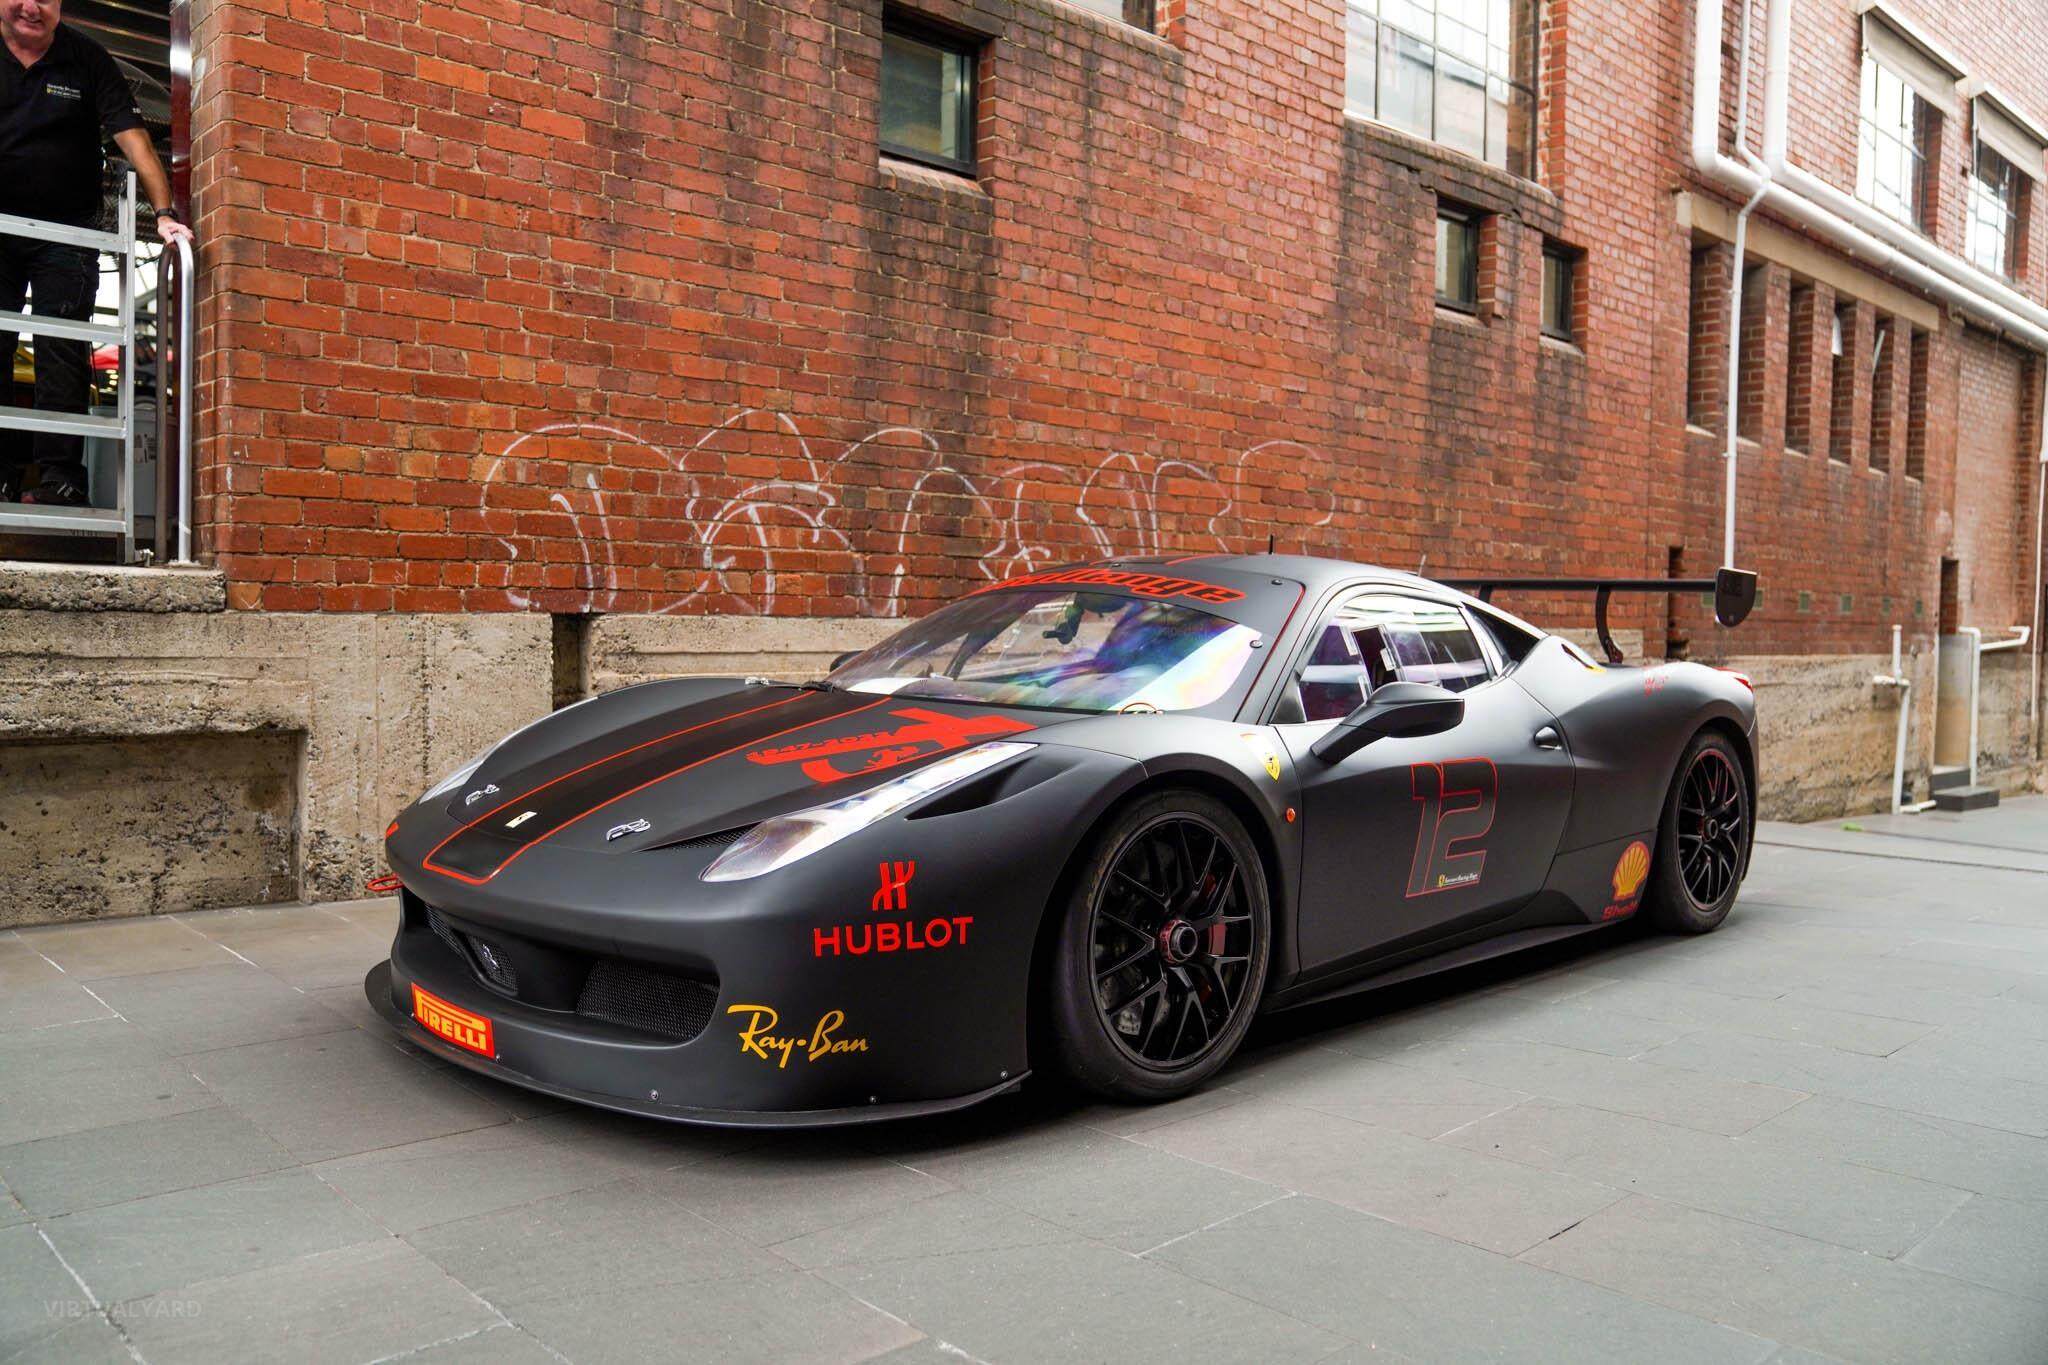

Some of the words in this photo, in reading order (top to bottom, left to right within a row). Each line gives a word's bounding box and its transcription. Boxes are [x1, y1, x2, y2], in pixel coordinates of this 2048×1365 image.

[1405, 756, 1498, 898] 12
[813, 916, 974, 957] HUBLOT
[414, 989, 487, 1051] PIRELLI
